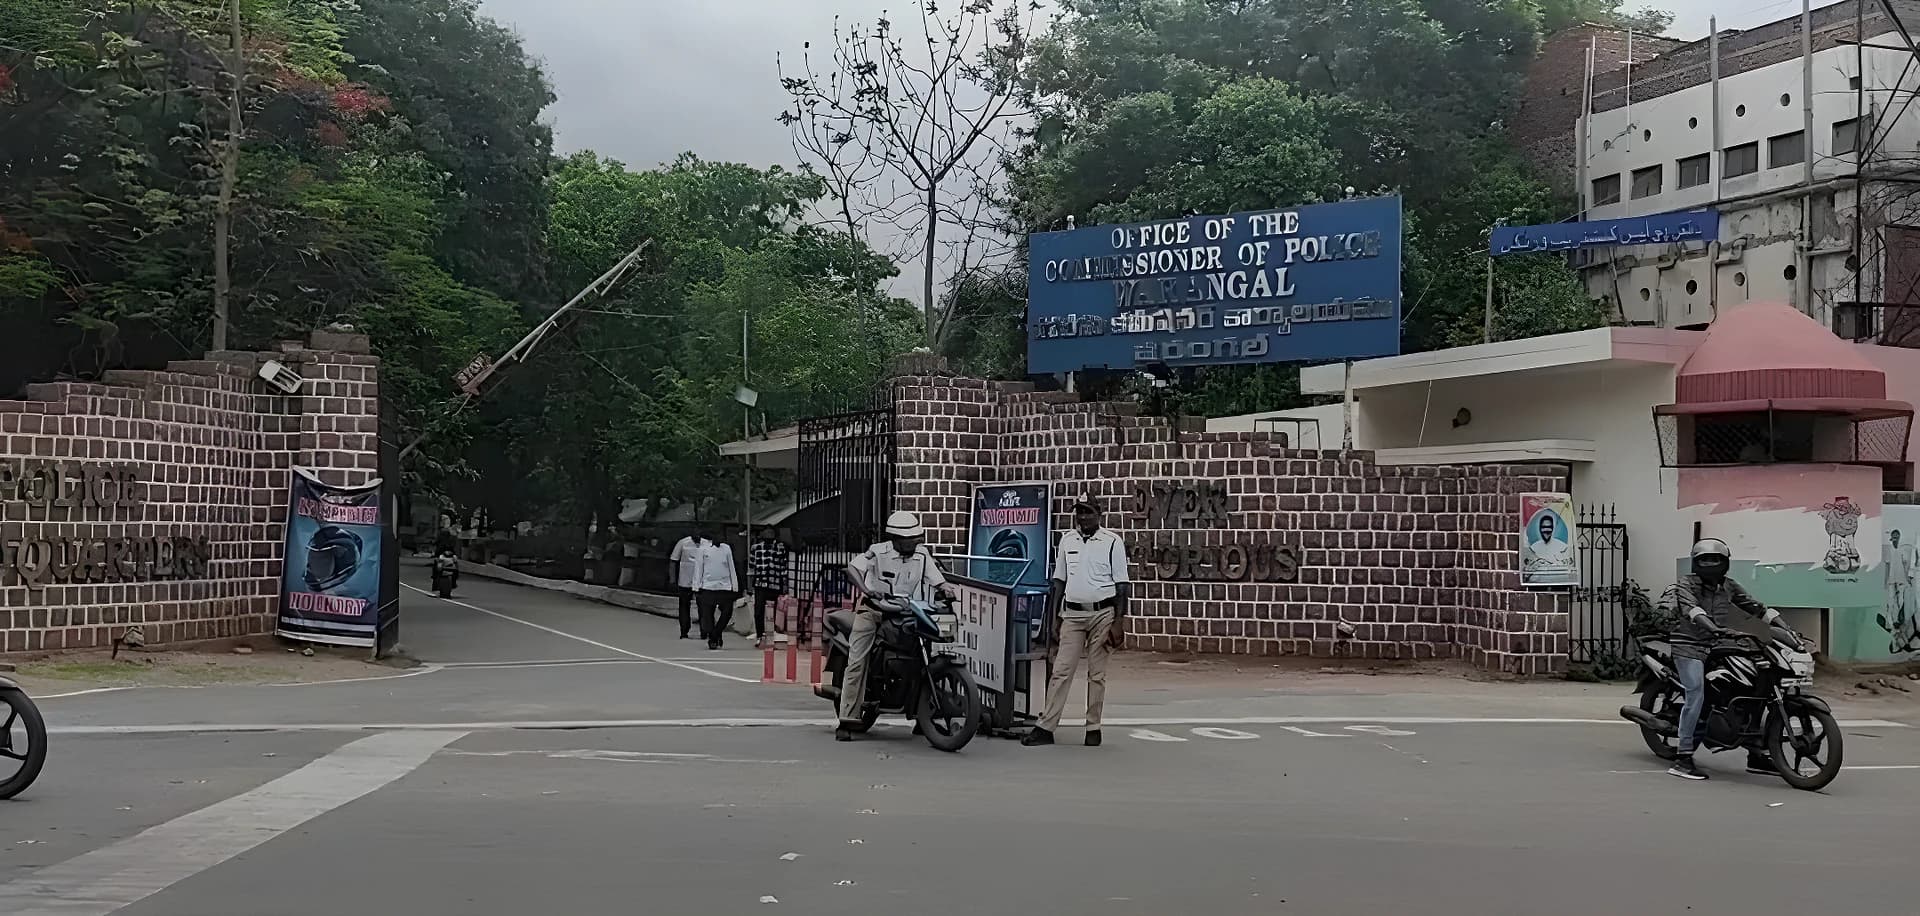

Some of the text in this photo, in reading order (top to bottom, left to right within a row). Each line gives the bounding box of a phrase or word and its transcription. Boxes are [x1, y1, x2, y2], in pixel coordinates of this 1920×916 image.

[1111, 211, 1300, 249] OFFICE OF THE
[1237, 240, 1271, 267] OF
[1284, 230, 1382, 263] POLICE
